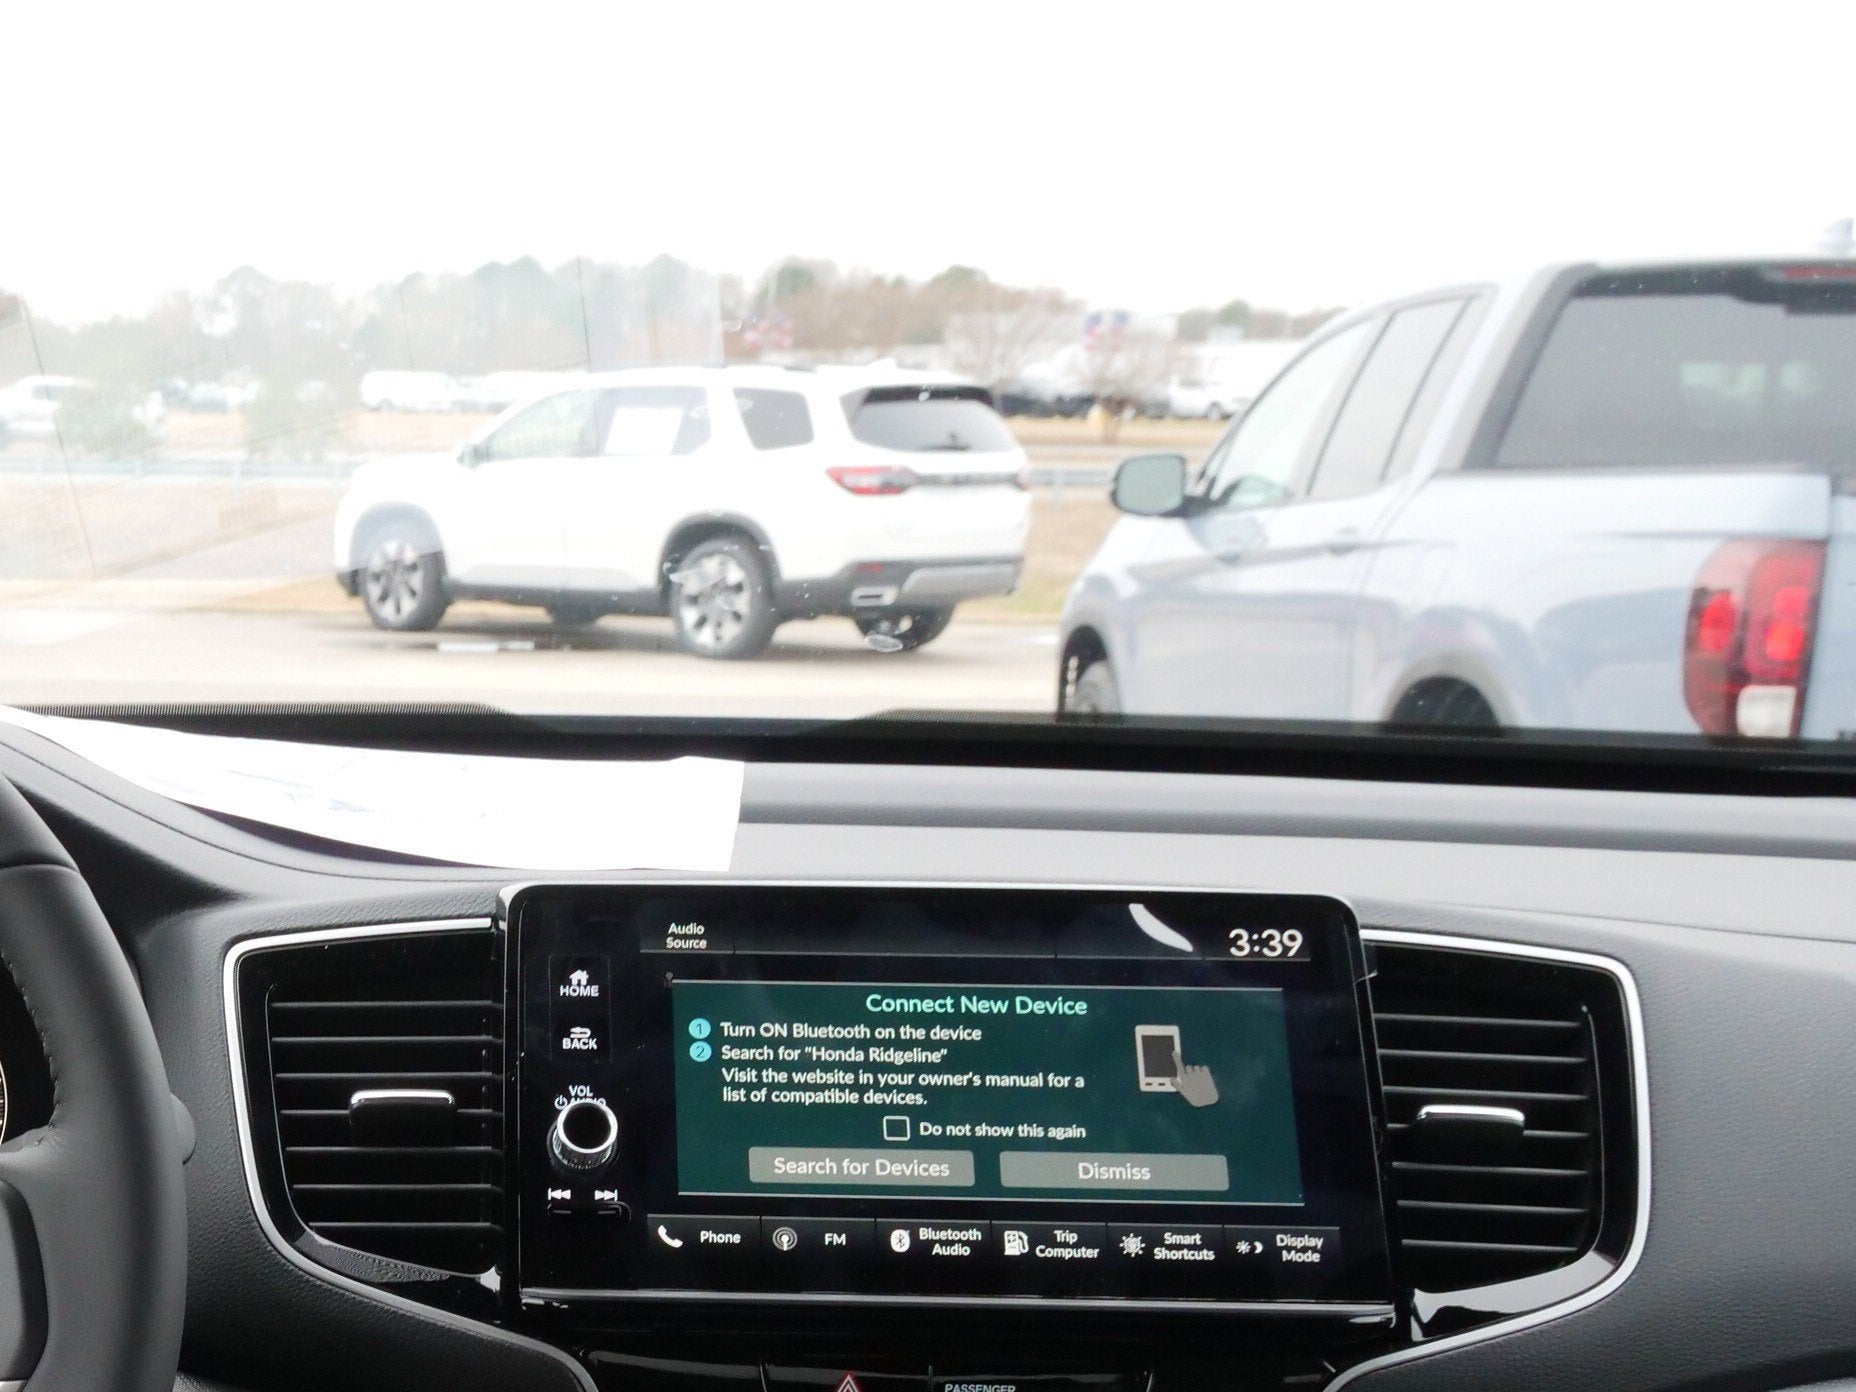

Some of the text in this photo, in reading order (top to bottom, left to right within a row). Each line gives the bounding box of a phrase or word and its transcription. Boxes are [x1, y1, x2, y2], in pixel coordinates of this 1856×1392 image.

[668, 922, 705, 935] Audio
[666, 937, 707, 949] Source
[1229, 928, 1303, 957] 3:39
[559, 985, 599, 997] HOME
[866, 994, 1088, 1015] Connect New Device
[720, 1022, 755, 1038] Turn
[759, 1023, 788, 1038] ON
[793, 1023, 871, 1040] Bluetooth
[875, 1028, 895, 1040] on
[899, 1026, 926, 1041] the
[930, 1026, 982, 1041] device
[562, 1038, 597, 1050] BACK
[721, 1045, 774, 1061] Search
[778, 1046, 801, 1061] for
[805, 1046, 864, 1062] "Honda
[869, 1047, 947, 1065] Ridgeline"
[722, 1068, 1085, 1088] Visit the website in your owner's manual for a
[569, 1085, 593, 1097] VOL
[723, 1087, 928, 1106] list of compatible devices.
[919, 1122, 1087, 1140] Do not show this again
[774, 1157, 950, 1177] Search for Devices
[1078, 1162, 1152, 1181] Dismiss
[700, 1230, 742, 1245] Phone
[824, 1232, 847, 1246] FM
[919, 1227, 982, 1242] Bluetooth
[1053, 1229, 1078, 1246] Trip
[1163, 1231, 1202, 1247] Smart
[1276, 1233, 1324, 1251] Display
[932, 1242, 971, 1257] Audio
[1035, 1244, 1099, 1261] Computer
[1153, 1245, 1215, 1262] Shortcuts
[1282, 1249, 1321, 1263] Mode
